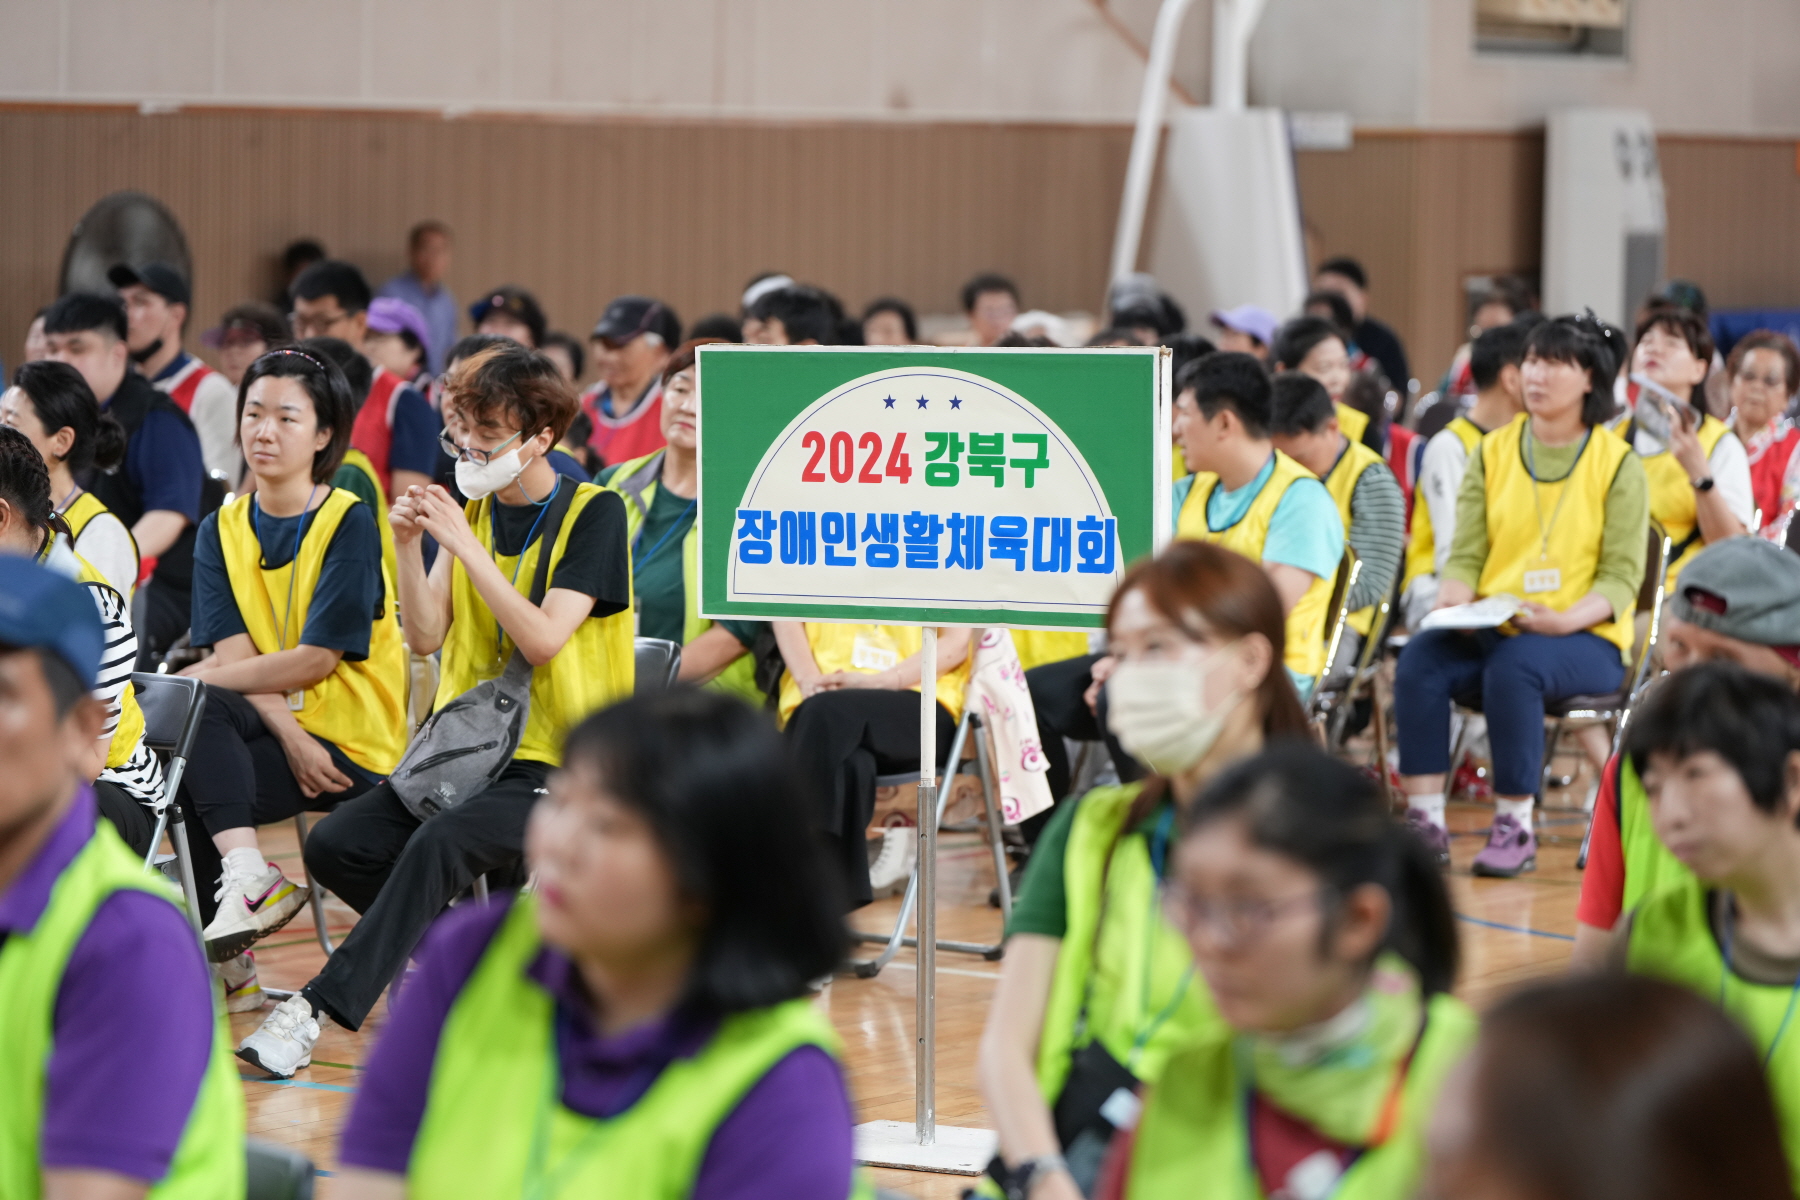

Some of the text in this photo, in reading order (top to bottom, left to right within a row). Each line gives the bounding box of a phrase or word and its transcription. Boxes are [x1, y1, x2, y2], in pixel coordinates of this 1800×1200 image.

[801, 430, 1050, 488] 2024 강북구
[737, 509, 1116, 575] 장애인생활체육대회
